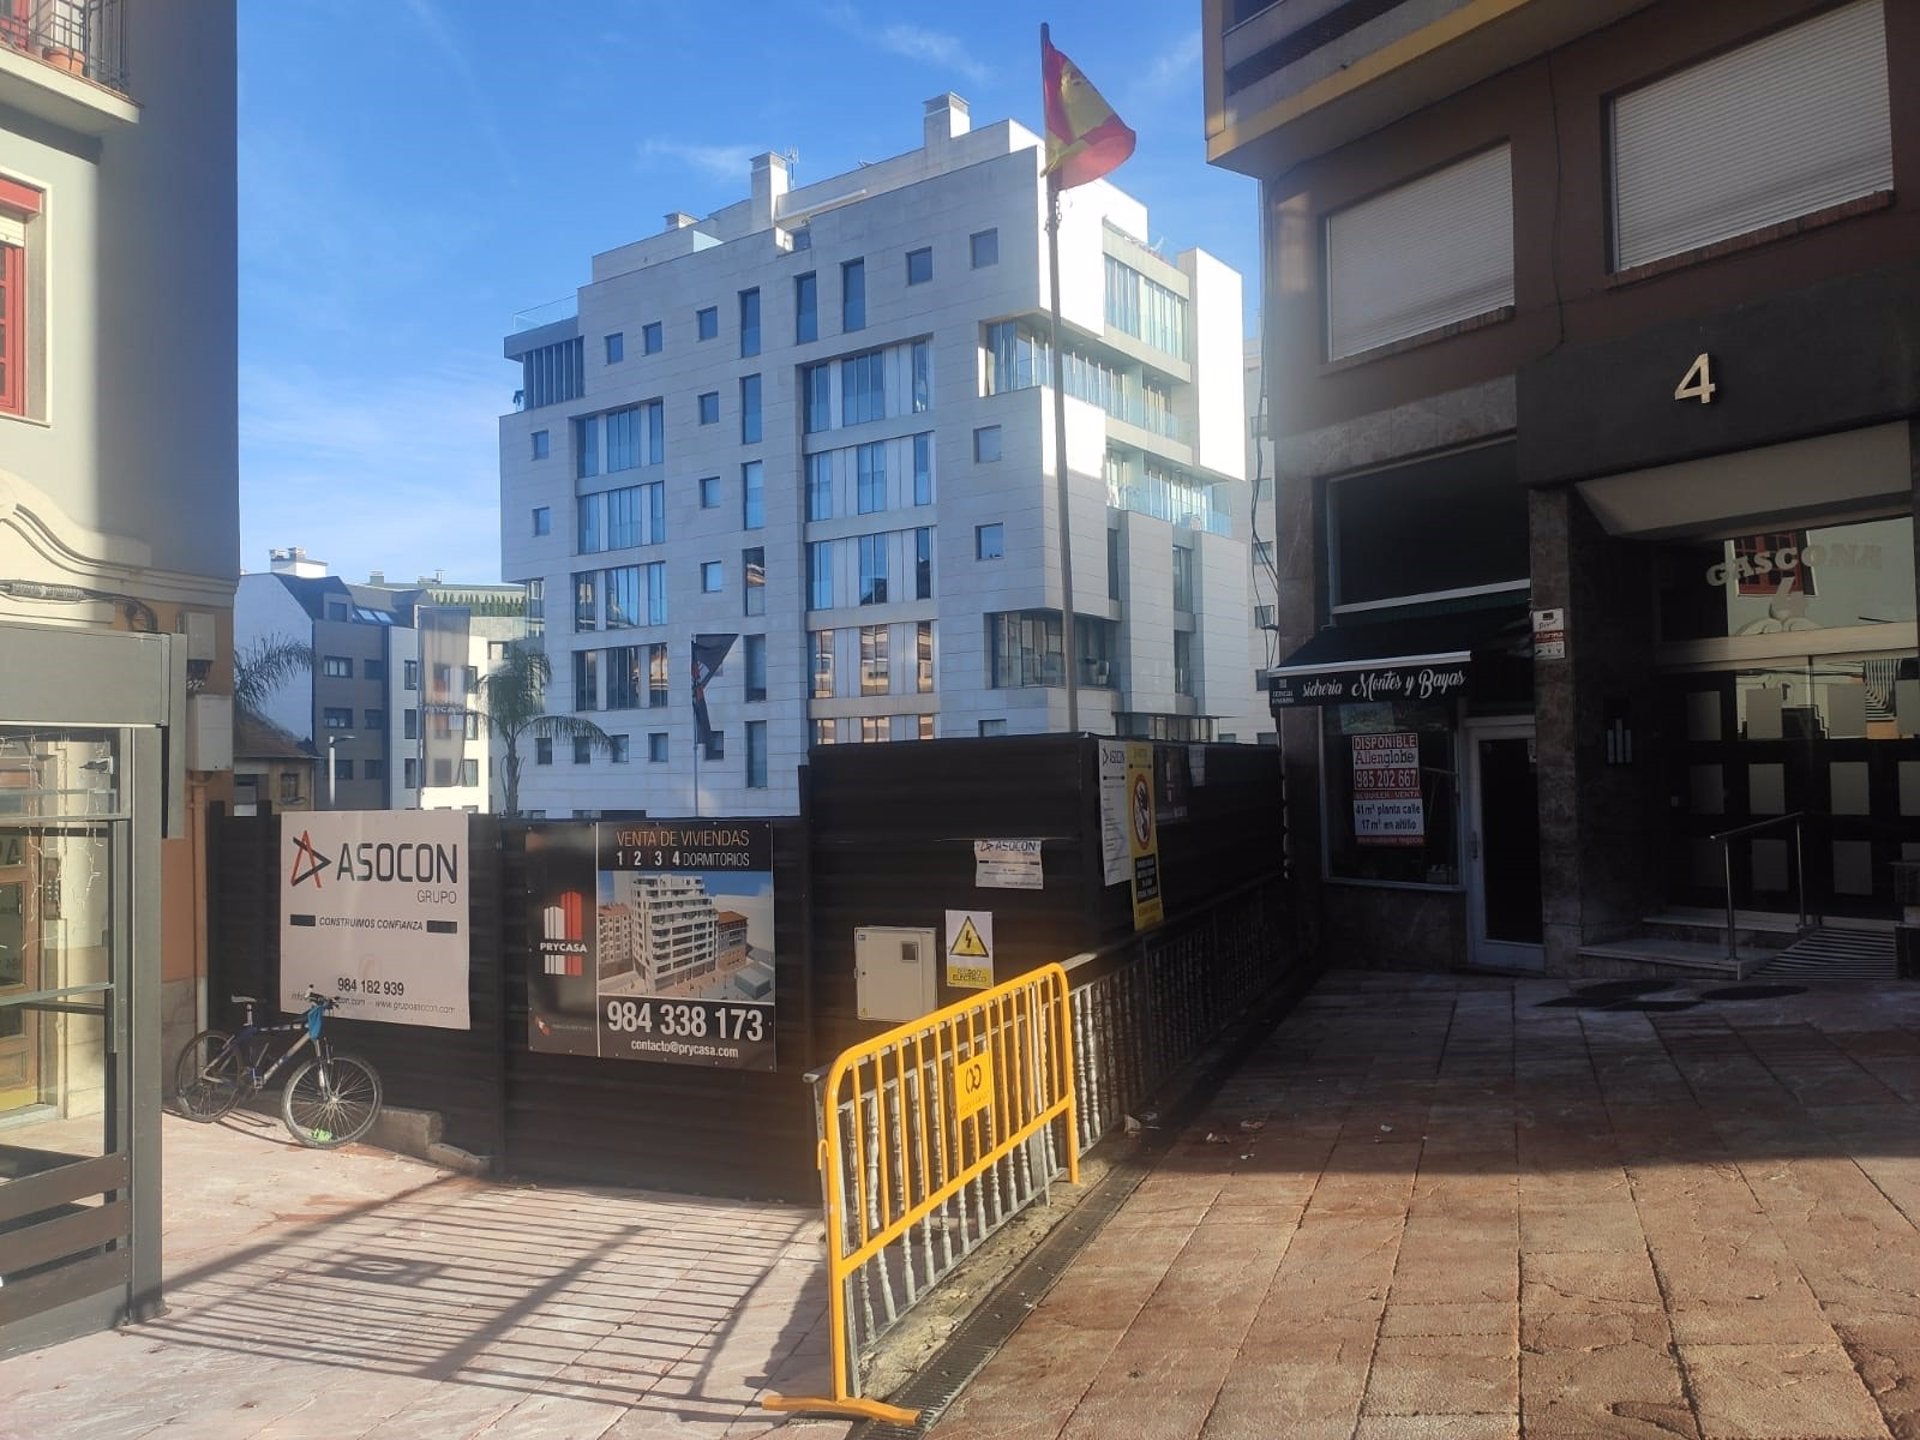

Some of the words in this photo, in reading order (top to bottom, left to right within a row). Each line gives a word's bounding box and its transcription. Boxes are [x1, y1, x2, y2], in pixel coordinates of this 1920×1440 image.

[1674, 353, 1716, 404] 4
[1351, 671, 1402, 702] Montes
[1404, 675, 1415, 697] y
[1419, 669, 1466, 699] Bayas
[1354, 736, 1416, 750] DISPONIBLE
[1356, 770, 1375, 788] 985
[1377, 770, 1395, 788] 202
[1398, 769, 1417, 787] 667
[1377, 804, 1401, 816] planta
[1402, 803, 1420, 814] calle
[616, 830, 656, 847] VENTA
[660, 830, 679, 847] DE
[681, 830, 750, 847] VIVIENDAS
[336, 843, 458, 884] ASOCON
[617, 851, 623, 865] 1
[634, 851, 642, 866] 2
[654, 851, 662, 866] 3
[672, 851, 680, 866] 4
[683, 852, 750, 867] DORMITORIOS
[417, 890, 457, 904] GRUPO
[319, 917, 375, 929] CONSTRUIMOS
[377, 919, 423, 931] CONFIANZA
[540, 942, 588, 953] PRYCASA
[337, 978, 357, 992] 984
[361, 980, 380, 994] 182
[384, 981, 405, 996] 939
[607, 1001, 653, 1034] 984
[660, 1003, 706, 1037] 338
[715, 1007, 763, 1041] 173
[631, 1039, 739, 1059] contacto@prycasa.com
